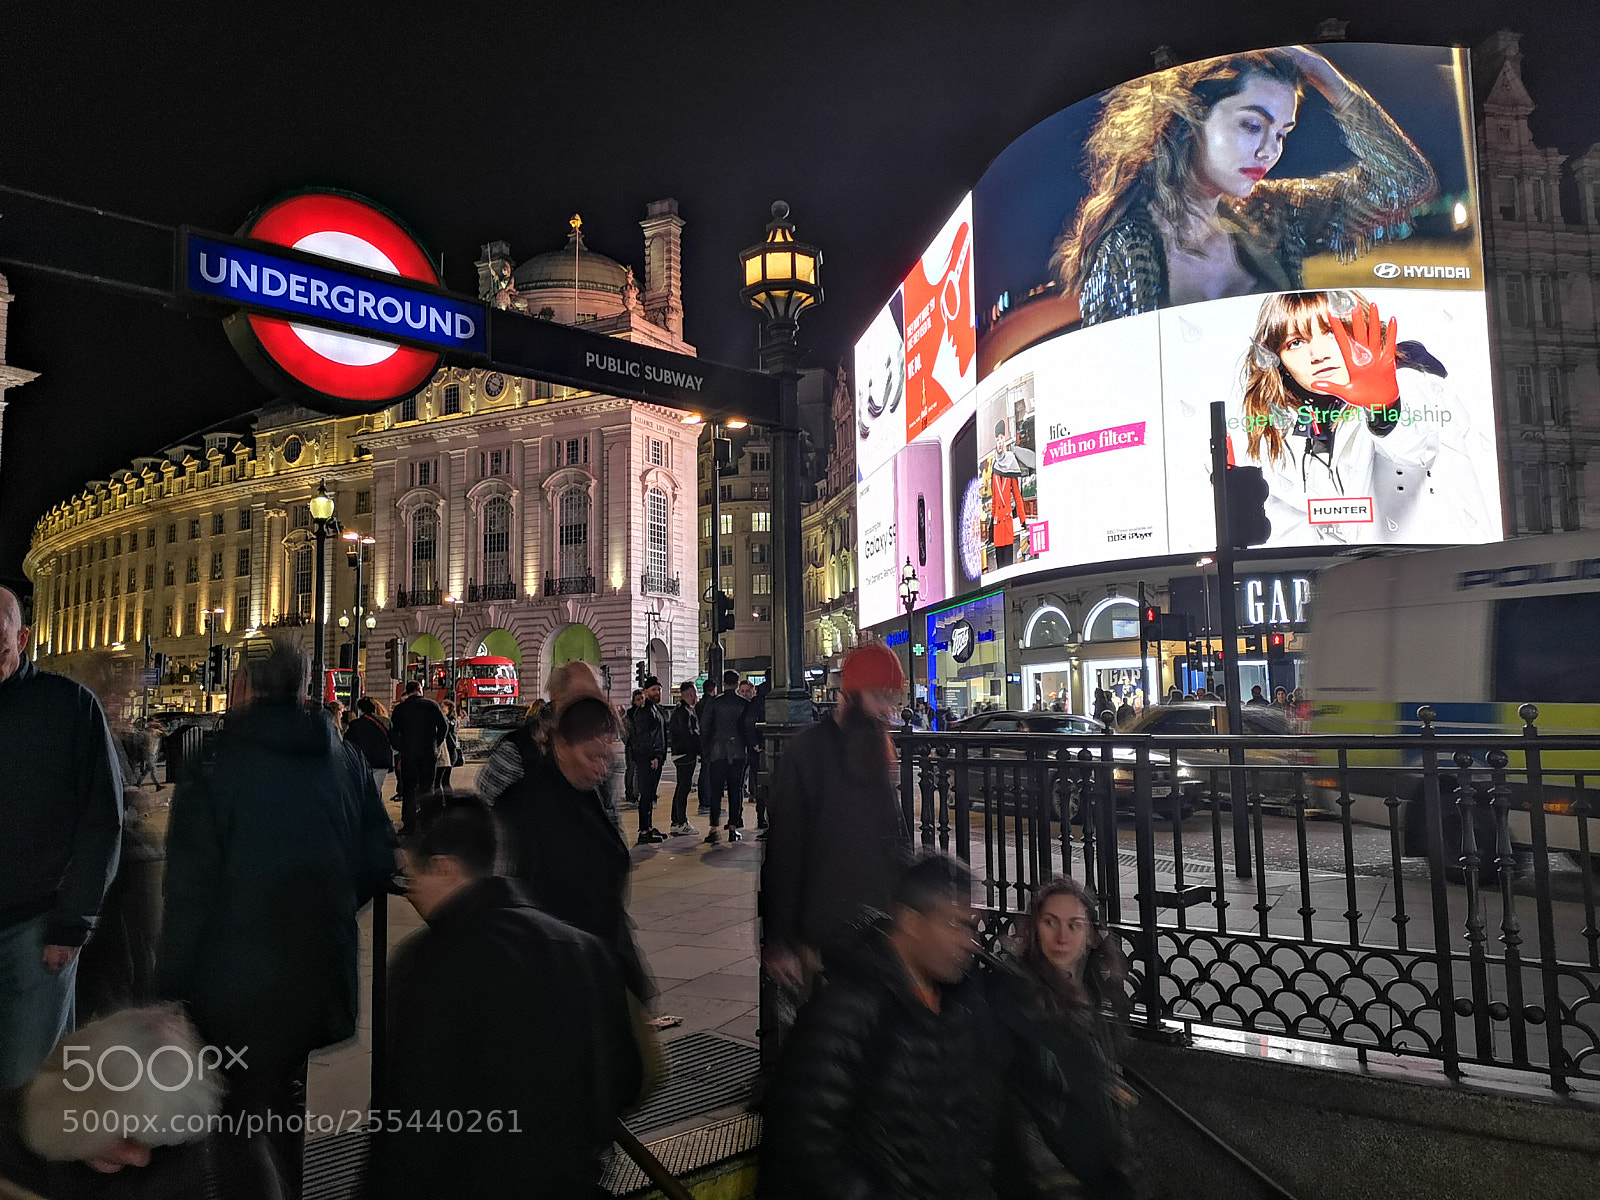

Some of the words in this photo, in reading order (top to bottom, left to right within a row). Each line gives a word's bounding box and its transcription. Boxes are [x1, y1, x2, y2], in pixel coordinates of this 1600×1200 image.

[1403, 265, 1471, 279] HYUNDAI
[199, 252, 476, 340] UNDERGROUND
[586, 351, 640, 378] PUBLIC
[644, 365, 704, 391] SUBWAY
[1298, 405, 1363, 424] Street
[1370, 403, 1452, 427] Flagship
[1049, 423, 1071, 440] life.
[1049, 439, 1077, 459] with
[1078, 438, 1096, 453] no
[1098, 429, 1140, 449] filter.
[1313, 506, 1367, 515] HUNTER
[1247, 578, 1311, 624] GAP
[1109, 669, 1141, 687] GAP
